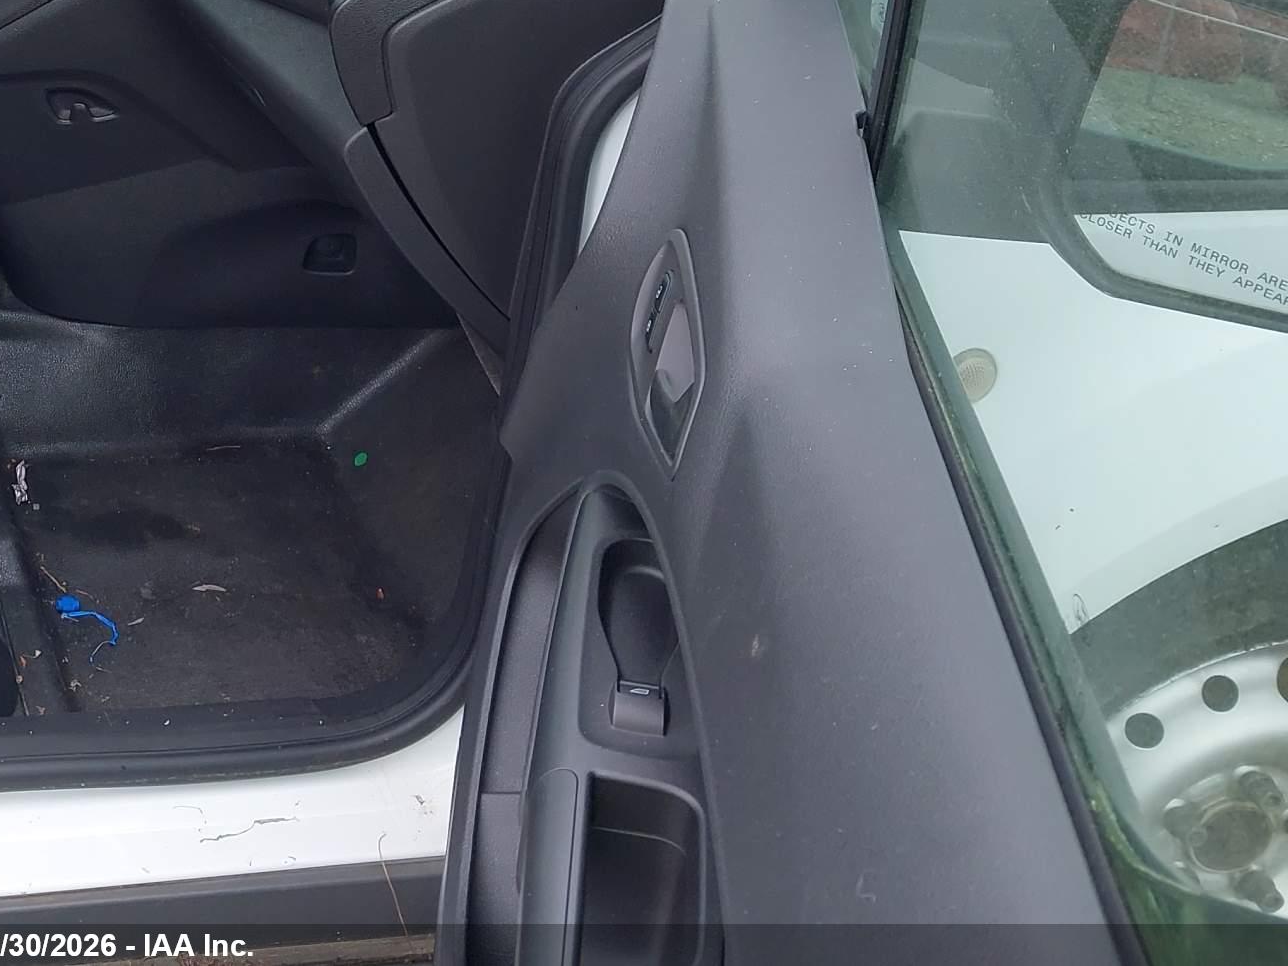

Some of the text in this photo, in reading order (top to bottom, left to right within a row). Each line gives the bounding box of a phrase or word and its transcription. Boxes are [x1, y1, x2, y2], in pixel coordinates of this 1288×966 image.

[1079, 212, 1133, 239] CLOSER
[1143, 235, 1179, 259] THAN
[1189, 255, 1226, 278] THEY
[1109, 211, 1288, 291] JECTS IN MIRROR ARE
